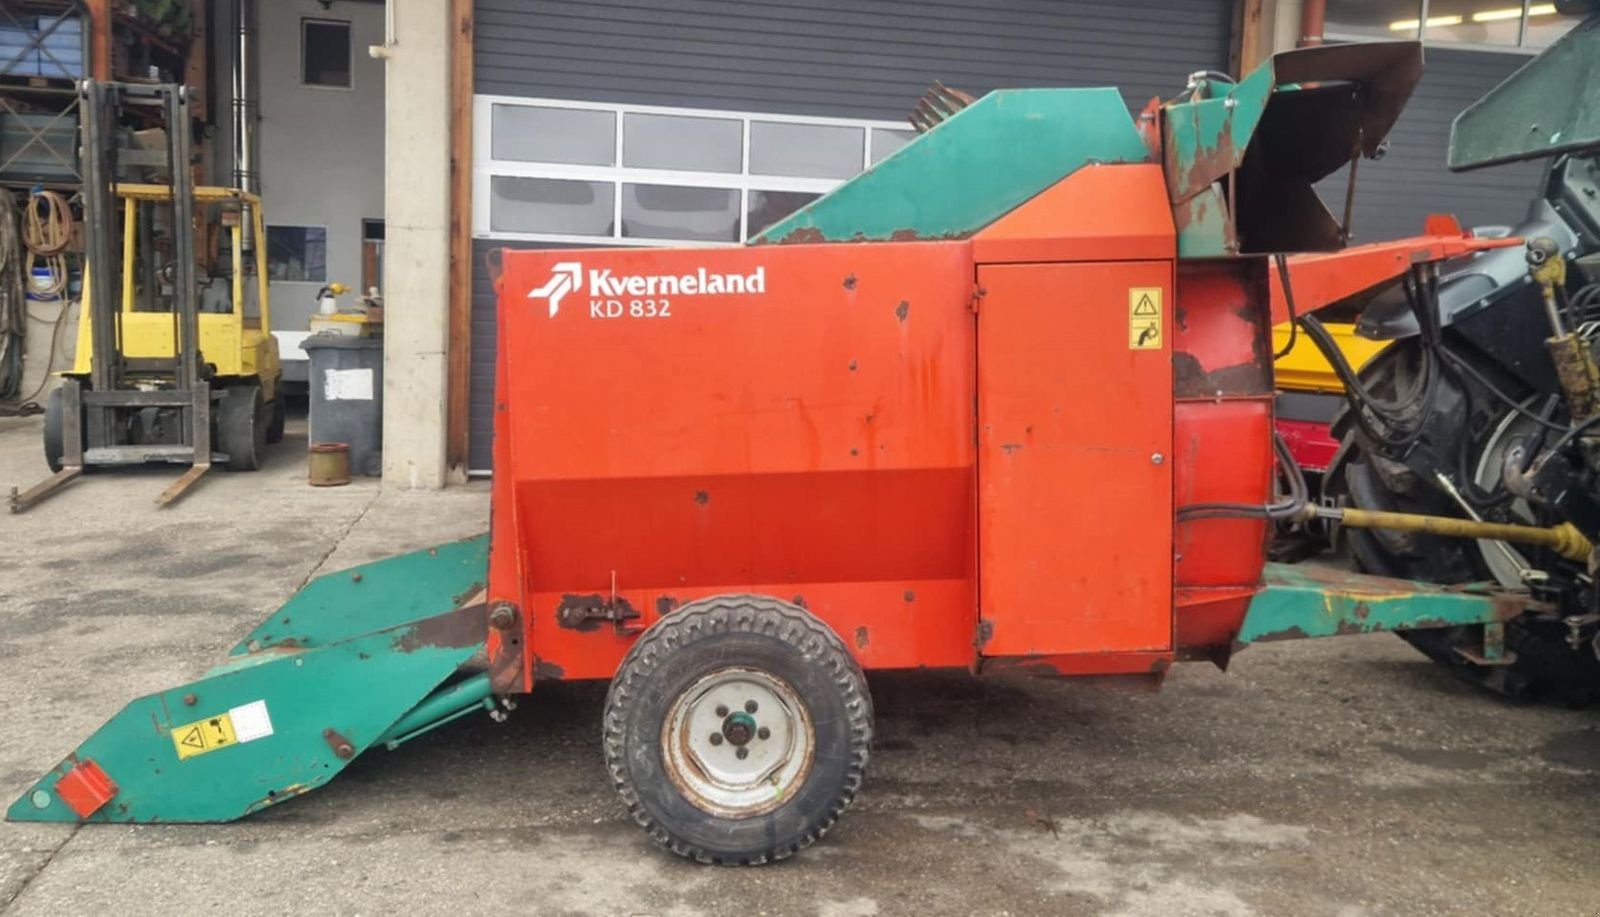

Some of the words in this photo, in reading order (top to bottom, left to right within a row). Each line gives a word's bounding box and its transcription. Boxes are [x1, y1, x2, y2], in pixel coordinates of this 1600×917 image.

[589, 266, 765, 297] Kverneland
[590, 300, 623, 318] KD
[629, 299, 671, 318] 832
